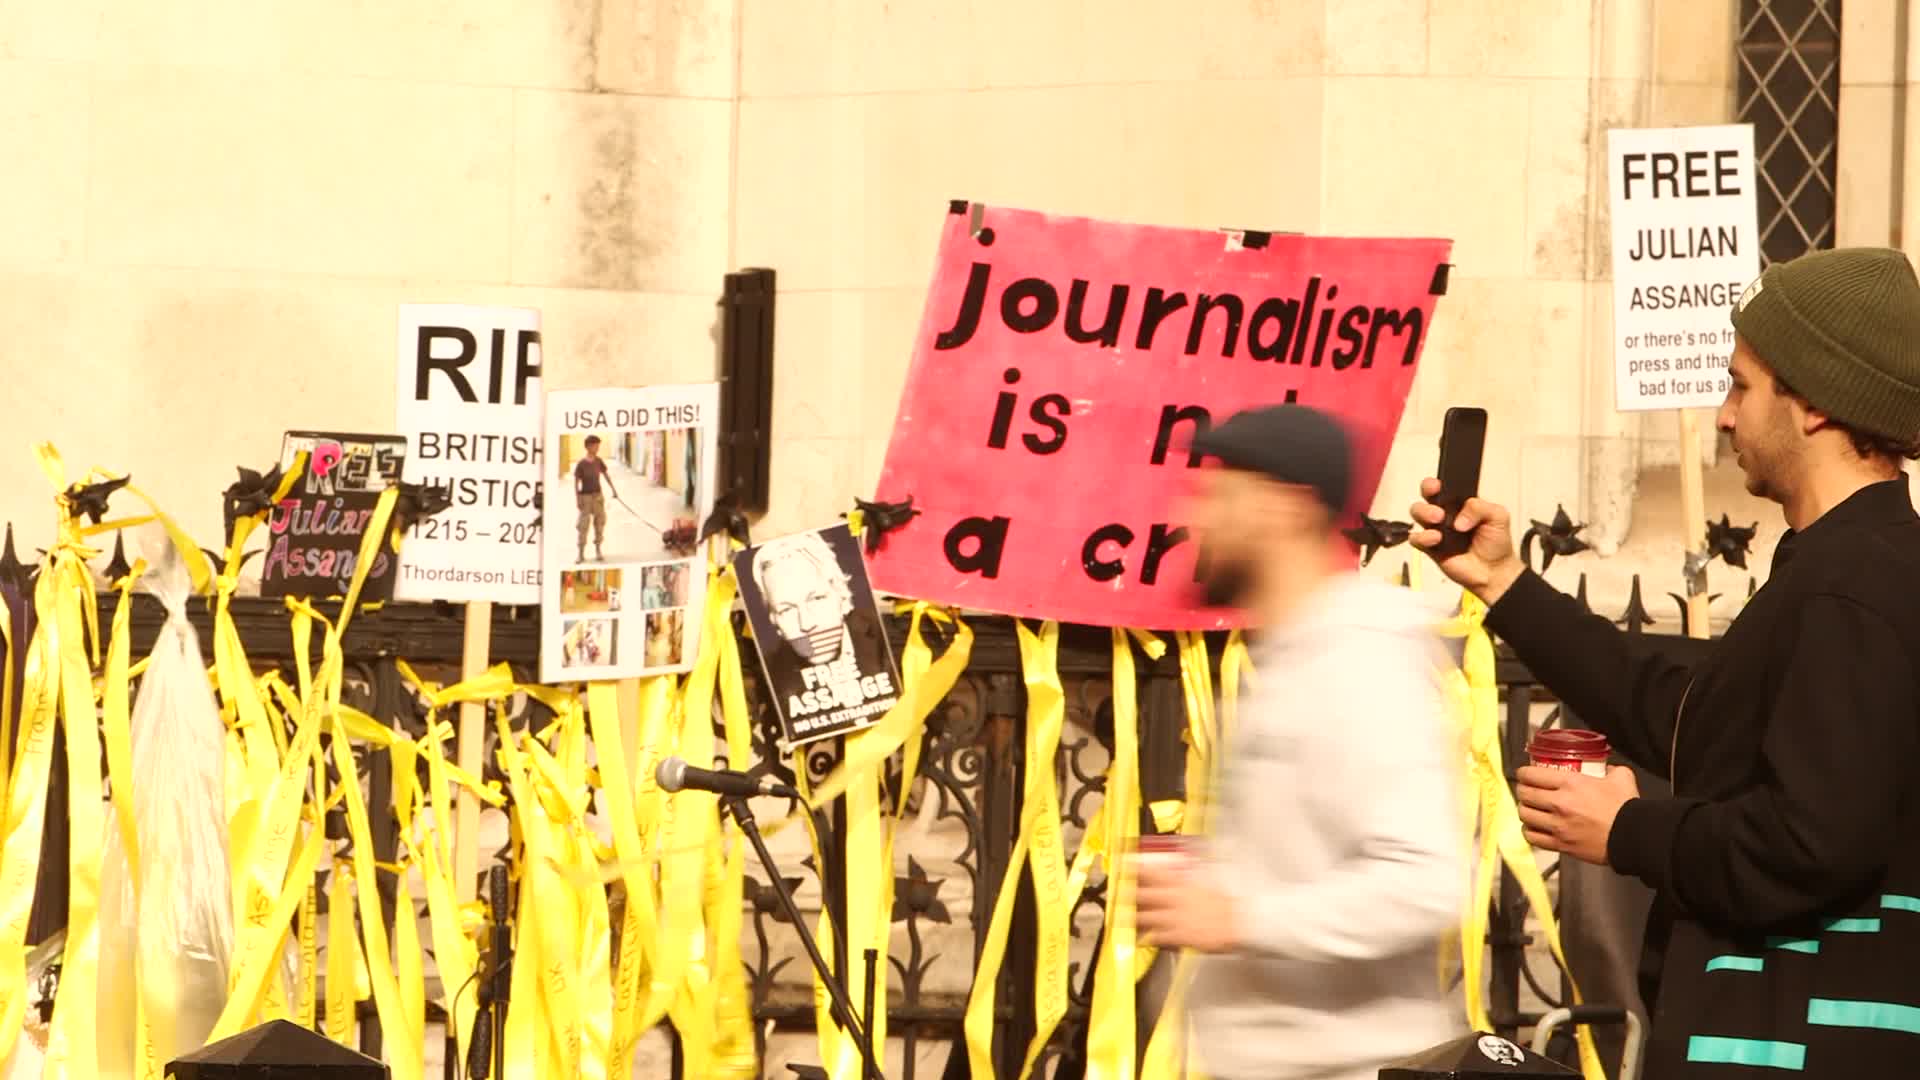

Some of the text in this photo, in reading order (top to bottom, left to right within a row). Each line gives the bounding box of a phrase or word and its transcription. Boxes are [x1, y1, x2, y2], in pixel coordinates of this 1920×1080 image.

[1623, 150, 1741, 200] FREE
[1629, 226, 1738, 261] JULIAN
[934, 227, 1422, 370] journalism
[1630, 282, 1741, 311] ASSANGE
[1624, 328, 1735, 349] or there's no fr
[1629, 353, 1730, 376] press and tha
[1639, 376, 1731, 396] bad for us al
[565, 404, 701, 429] USA DID THIS!
[987, 368, 1071, 455] is
[498, 520, 542, 544] 202
[943, 515, 1010, 579] a
[402, 564, 505, 584] Thordarson
